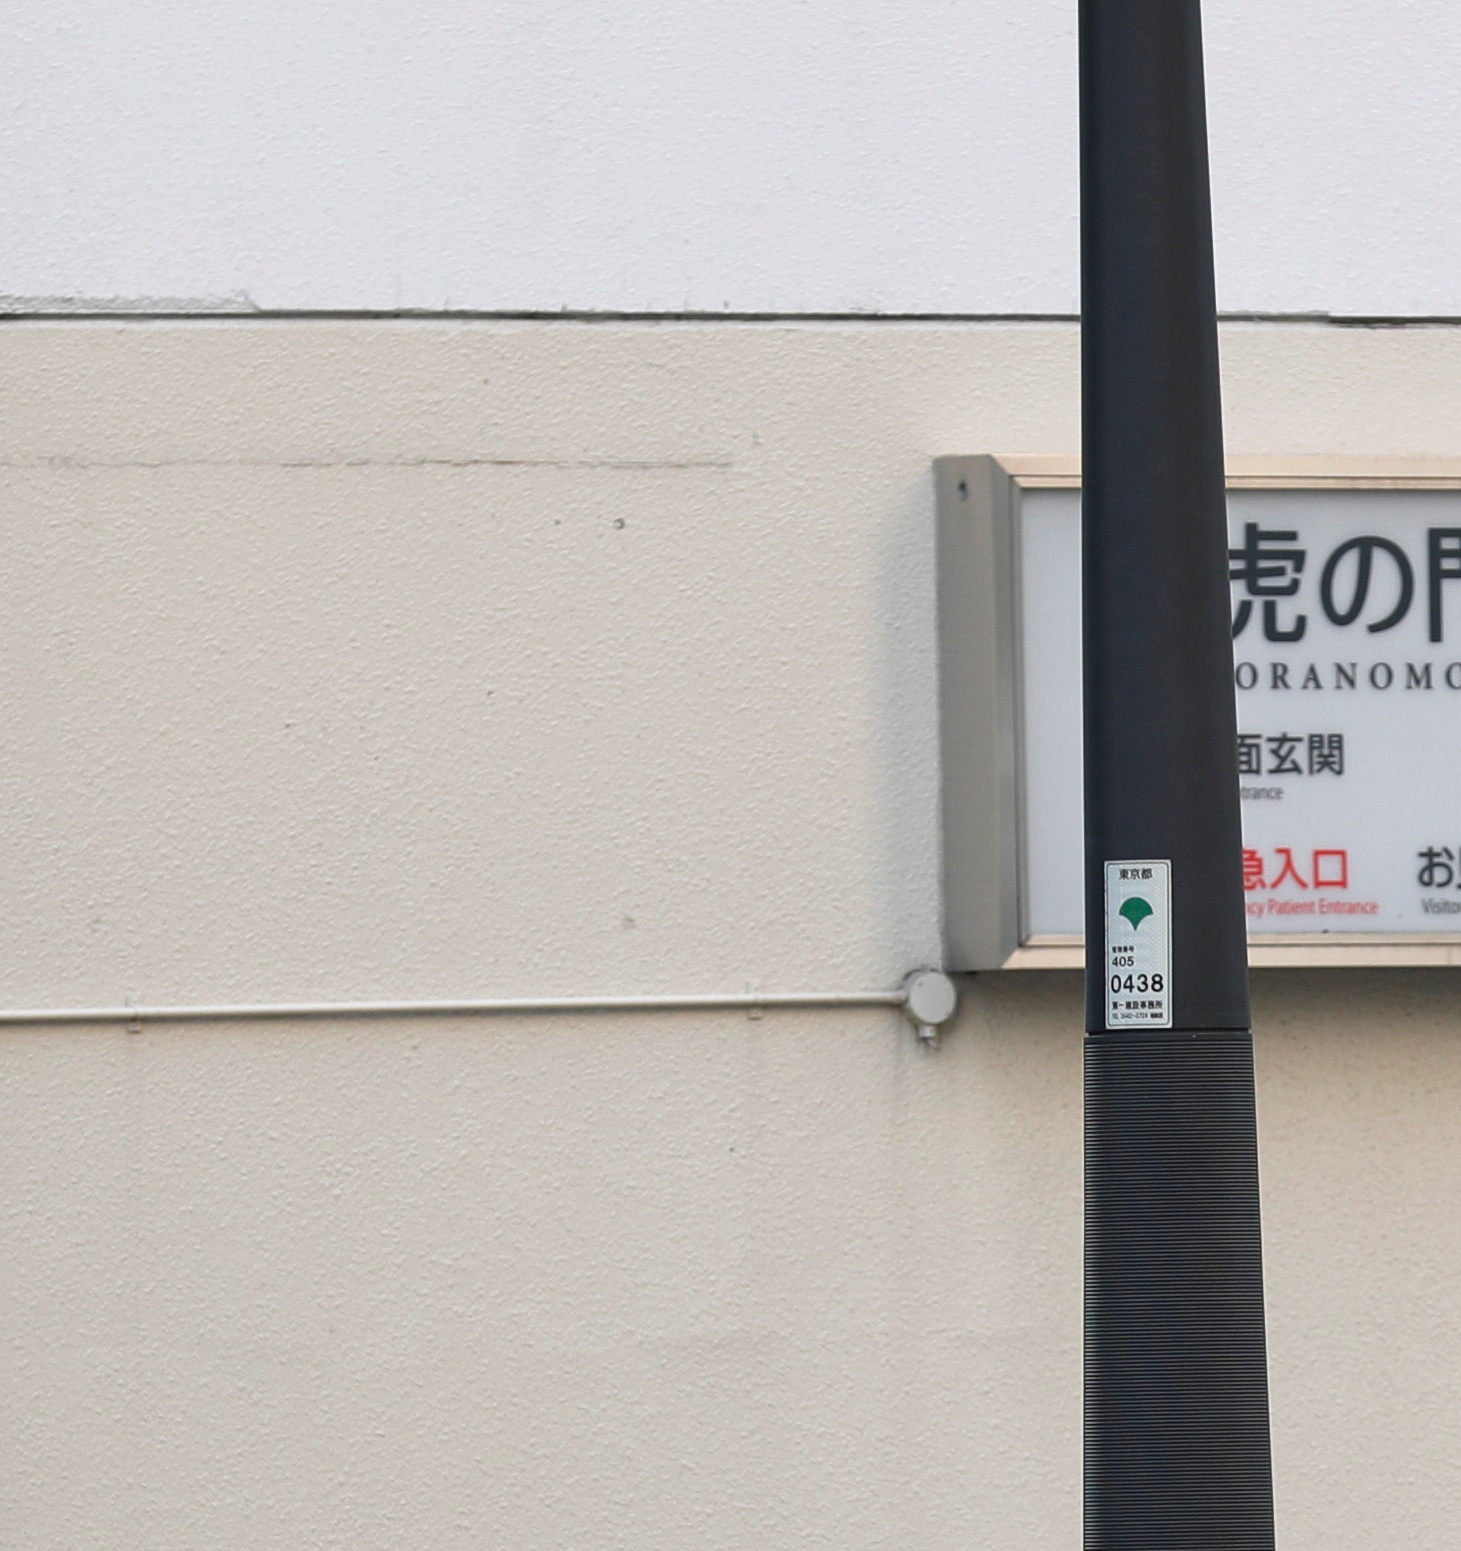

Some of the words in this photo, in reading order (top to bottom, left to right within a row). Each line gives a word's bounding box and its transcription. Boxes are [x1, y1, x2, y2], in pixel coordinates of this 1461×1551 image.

[1237, 732, 1345, 776] 面玄関
[1240, 786, 1284, 801] trance
[1119, 868, 1153, 880] 東京都
[1242, 847, 1349, 892] 急入口
[1267, 898, 1315, 915] Patient
[1319, 898, 1379, 915] Entrance
[1112, 955, 1134, 968] 405
[1110, 973, 1164, 994] 0438
